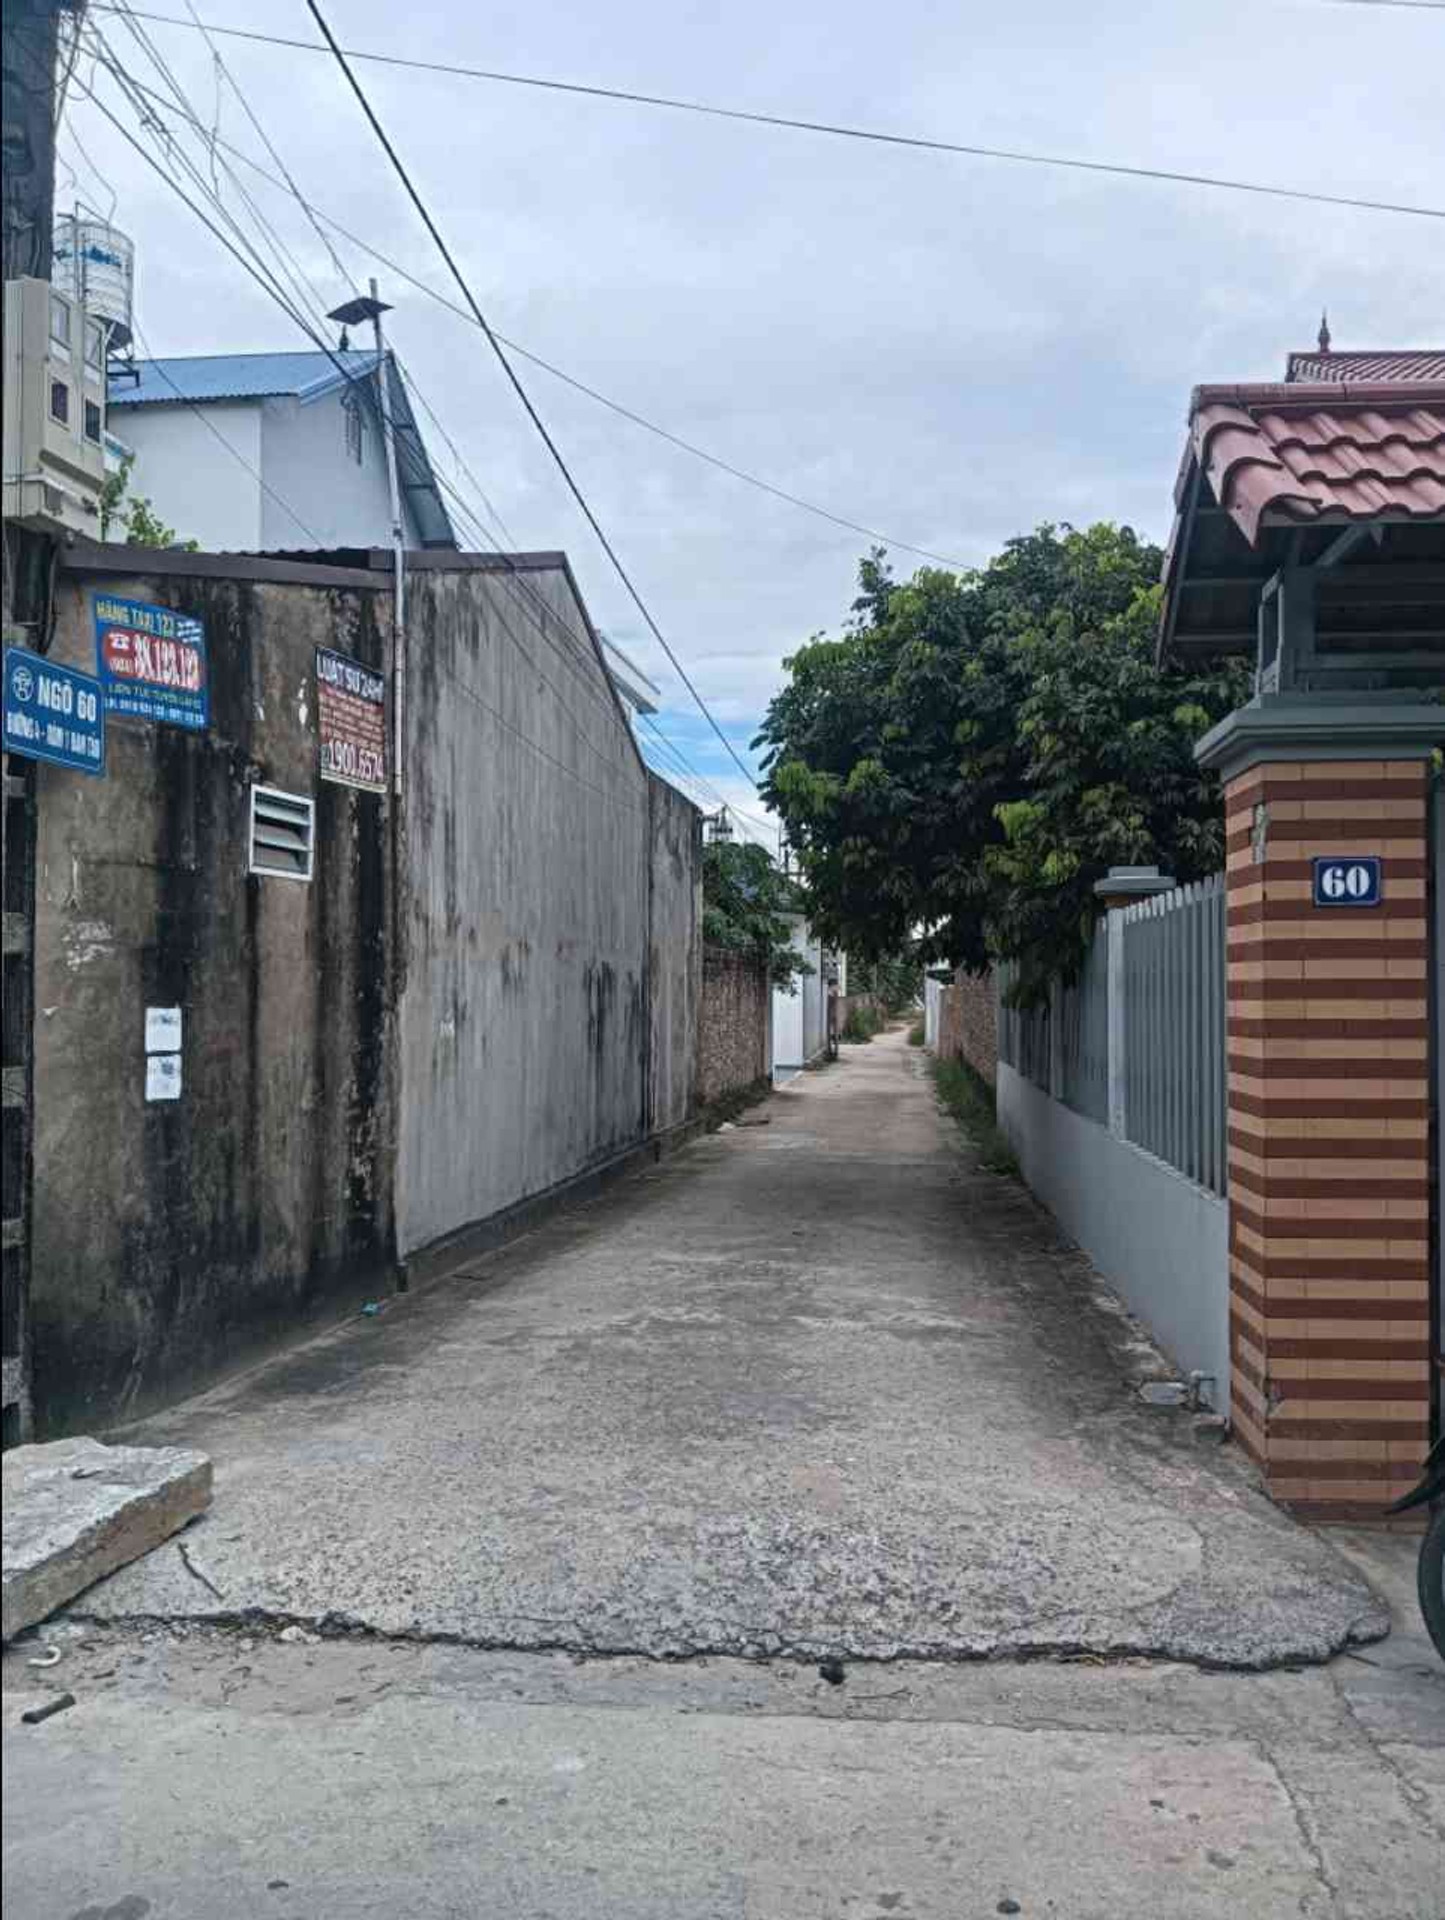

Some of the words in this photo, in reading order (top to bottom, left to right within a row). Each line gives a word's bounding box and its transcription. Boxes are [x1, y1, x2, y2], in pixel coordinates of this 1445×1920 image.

[38, 674, 72, 714] NGÕ
[77, 689, 96, 723] 60
[1322, 866, 1370, 898] 60
